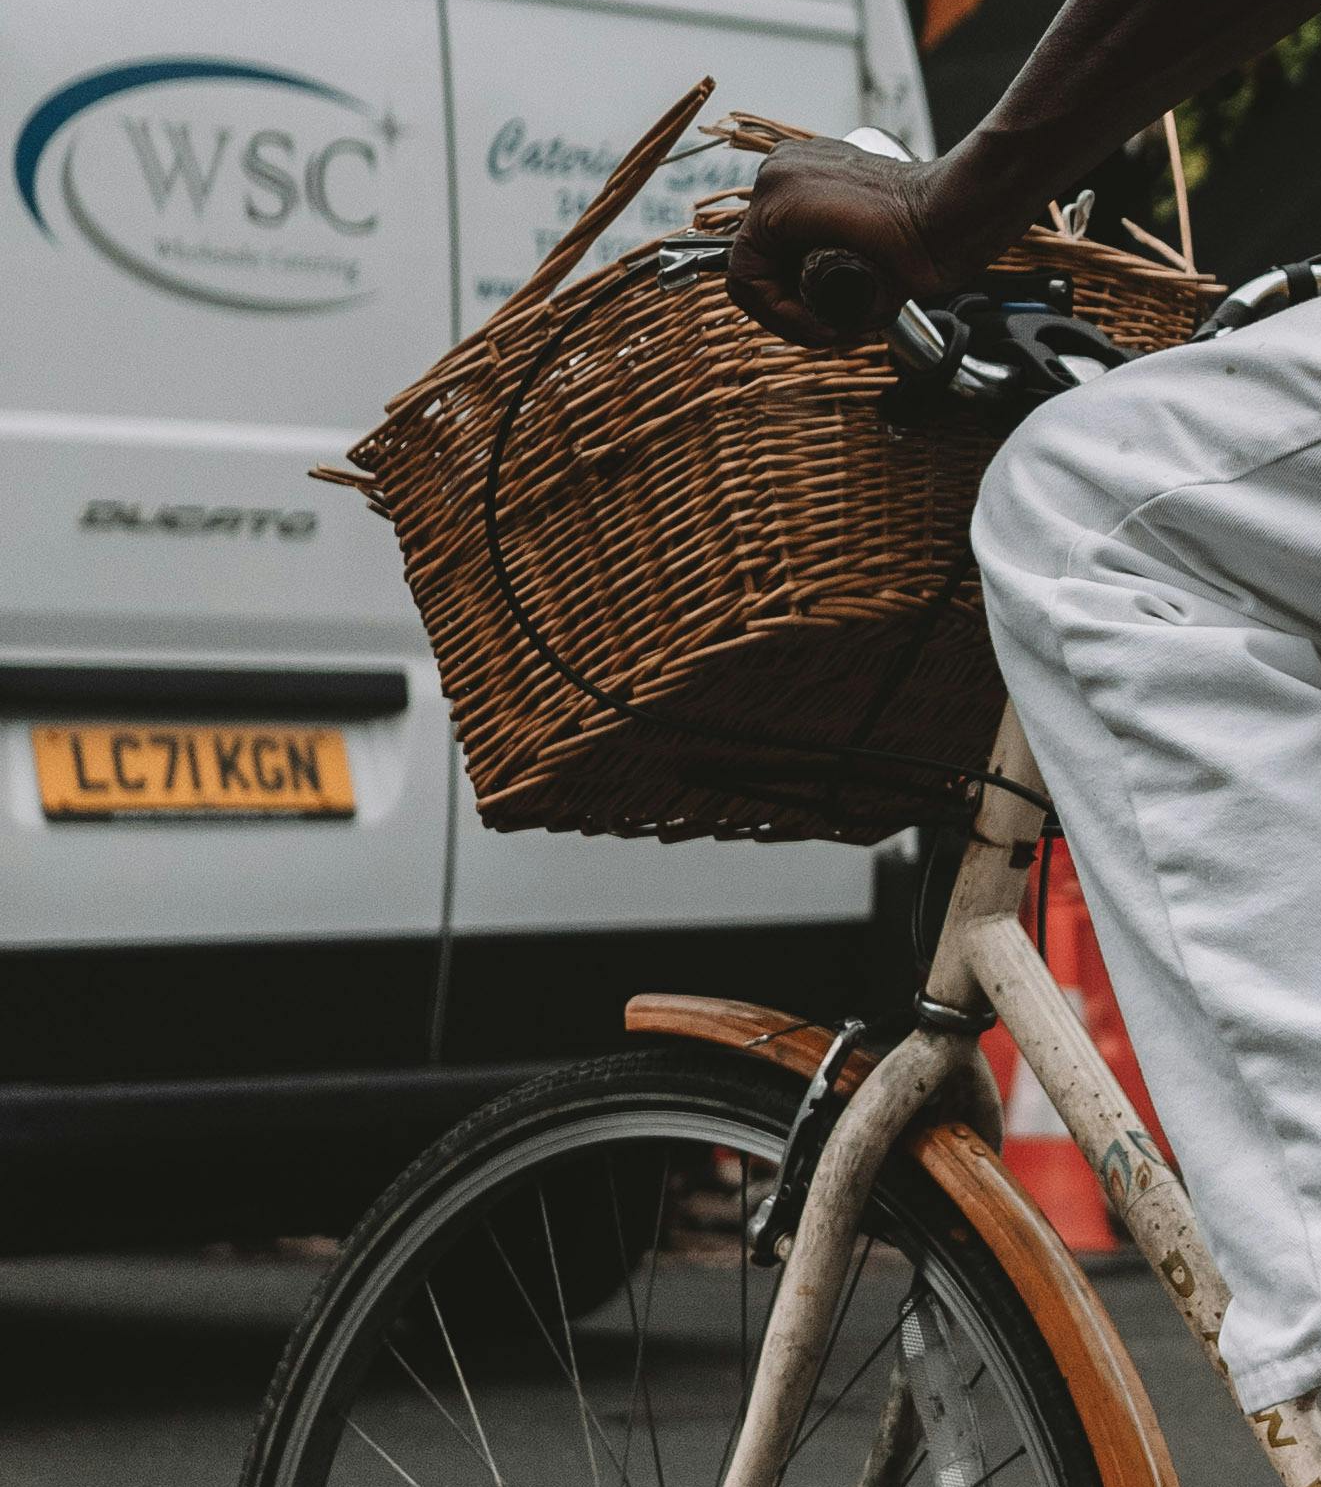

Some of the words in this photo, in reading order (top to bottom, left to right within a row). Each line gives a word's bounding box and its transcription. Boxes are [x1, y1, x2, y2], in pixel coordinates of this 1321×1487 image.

[122, 115, 379, 237] WSC
[79, 499, 318, 543] DUCATO
[69, 731, 203, 794] LC71
[214, 732, 323, 794] KGN
